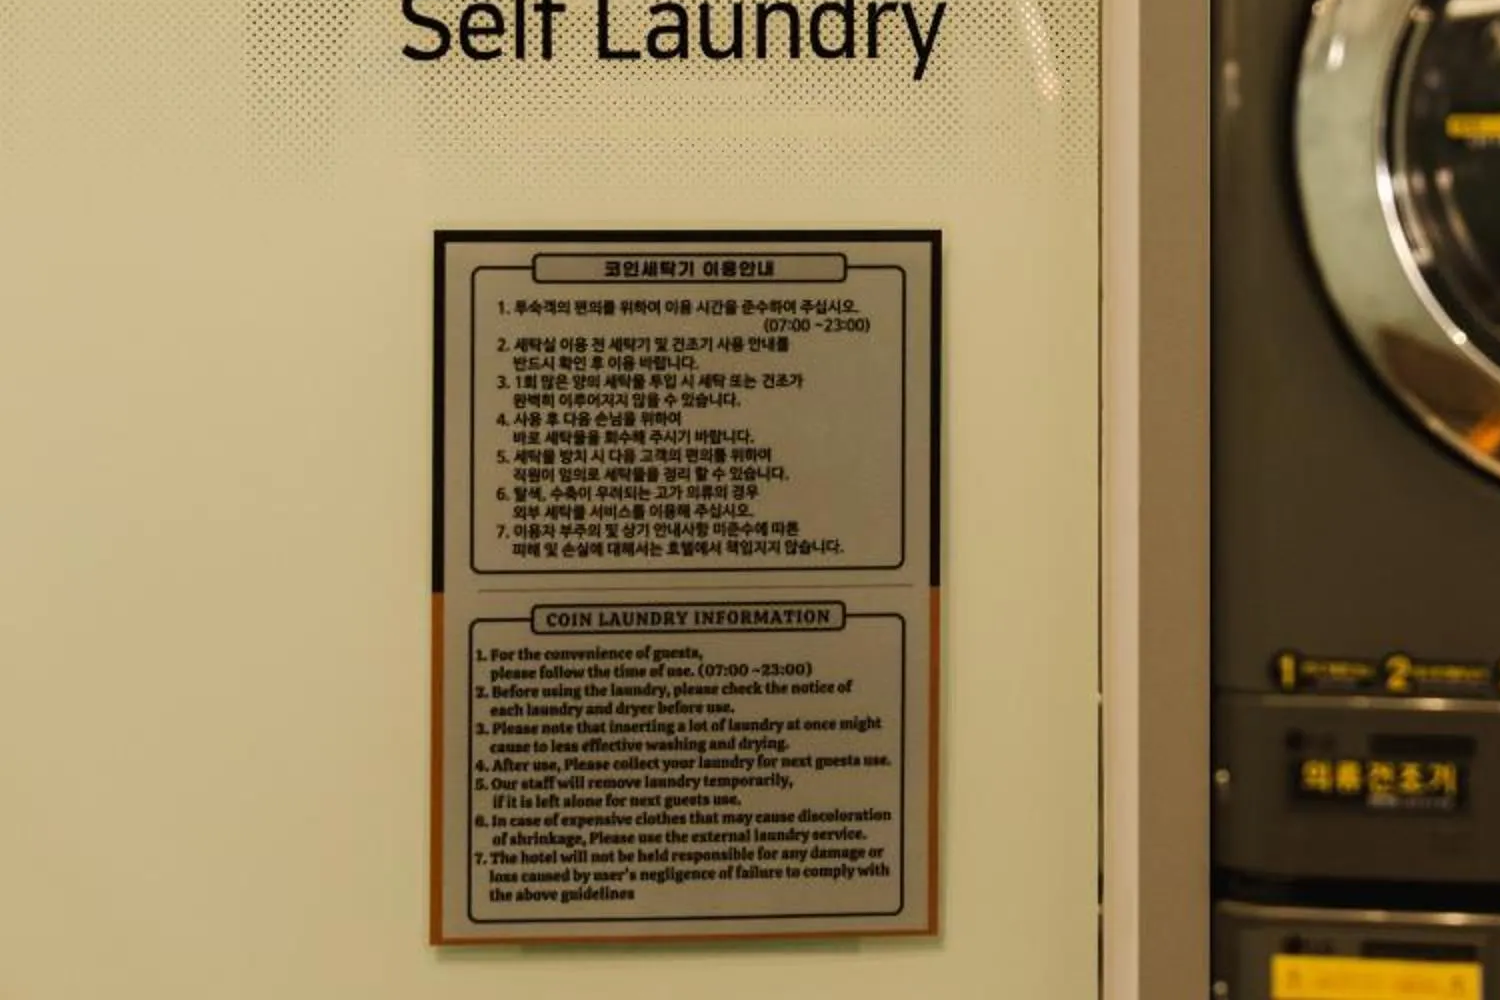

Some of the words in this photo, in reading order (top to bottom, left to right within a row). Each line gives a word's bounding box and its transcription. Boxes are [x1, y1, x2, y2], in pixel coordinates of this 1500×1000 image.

[604, 260, 694, 277] 코인세탁기
[702, 259, 774, 277] 이용안내
[498, 300, 510, 314] 1.
[574, 299, 616, 315] 편의를
[619, 299, 660, 316] 위하여
[664, 299, 692, 315] 이용
[696, 299, 738, 315] 시간을
[741, 299, 796, 315] 준수하여
[800, 299, 859, 314] 주십시오.
[496, 337, 510, 352] 2.
[513, 336, 556, 353] 세탁실
[559, 336, 588, 353] 이용
[591, 336, 604, 353] 전
[608, 336, 650, 352] 세탁기
[654, 336, 668, 352] 및
[672, 336, 712, 352] 건조기
[716, 336, 744, 352] 사용
[512, 355, 554, 371] 반드시
[558, 355, 586, 371] 확인
[590, 355, 604, 370] 후
[607, 354, 636, 371] 이용
[558, 392, 628, 408] 이루어지지
[664, 392, 678, 408] 수
[681, 391, 740, 408] 있습니다.
[496, 412, 509, 426] 4.
[513, 411, 542, 428] 사용
[545, 411, 560, 427] 후
[563, 411, 592, 427] 다음
[594, 410, 636, 427] 손님을
[640, 410, 681, 426] 위하여
[512, 430, 540, 445] 바로
[544, 429, 600, 446] 세탁물을
[649, 429, 690, 445] 주시기
[603, 465, 659, 482] 세탁물을
[694, 465, 708, 482] 할
[712, 466, 726, 482] 수
[729, 465, 789, 481] 있습니다.
[546, 612, 592, 627] COIN
[598, 610, 688, 627] LAUNDRY
[694, 609, 830, 625] INFORMATION
[476, 648, 487, 661] 1.
[490, 648, 515, 662] For
[515, 647, 542, 660] the
[543, 646, 633, 660] convenience
[635, 645, 651, 659] of
[651, 646, 703, 662] guests,
[490, 665, 536, 682] please
[539, 664, 585, 679] follow
[586, 663, 610, 679] the
[613, 663, 646, 678] time
[649, 662, 665, 677] of
[666, 666, 694, 677] use.
[1279, 652, 1296, 690] 1
[1385, 653, 1411, 692] 2
[476, 687, 488, 699] 2.
[492, 683, 539, 698] Before
[541, 683, 582, 700] using
[584, 683, 608, 696] the
[610, 682, 670, 698] laundry,
[673, 681, 719, 698] please
[721, 681, 763, 695] check
[764, 680, 788, 694] the
[791, 679, 834, 694] notice
[836, 679, 852, 693] of
[489, 703, 523, 717] each
[526, 701, 584, 719] laundry
[585, 701, 612, 715] and
[615, 700, 655, 717] dryer
[657, 699, 704, 714] before
[706, 703, 734, 713] use.
[489, 742, 530, 753] cause
[532, 740, 548, 753] to
[550, 739, 578, 753] less
[581, 737, 643, 752] effective
[644, 736, 706, 755] washing
[708, 735, 736, 750] and
[738, 735, 789, 754] drying.
[475, 761, 489, 771] 4.
[491, 757, 530, 772] After
[532, 760, 562, 773] use,
[562, 756, 610, 771] Please
[612, 755, 660, 770] collect
[661, 758, 696, 772] your
[697, 754, 754, 771] laundry
[757, 754, 778, 768] for
[780, 755, 812, 767] next
[815, 754, 860, 770] guests
[863, 755, 891, 766] use.
[475, 779, 488, 790] 5.
[490, 777, 518, 790] Our
[520, 775, 556, 790] staff
[556, 775, 584, 789] will
[587, 778, 642, 789] remove
[644, 774, 700, 790] laundry
[703, 773, 793, 790] temporarily,
[492, 793, 504, 808] if
[504, 794, 517, 808] it
[520, 794, 532, 808] is
[535, 793, 560, 808] left
[563, 793, 602, 808] alone
[605, 792, 627, 807] for
[629, 794, 661, 807] next
[664, 793, 710, 809] guests
[713, 794, 741, 805] use.
[475, 816, 488, 827] 6.
[491, 814, 506, 827] In
[509, 816, 541, 827] case
[543, 812, 559, 827] of
[560, 811, 632, 829] expensive
[634, 810, 686, 825] clothes
[689, 810, 719, 824] that
[721, 813, 753, 826] may
[754, 812, 795, 823] cause
[796, 808, 891, 822] discoloration
[475, 854, 488, 865] 7.
[489, 850, 518, 864] The
[520, 849, 557, 864] hotel
[559, 849, 587, 863] will
[590, 850, 614, 863] not
[617, 848, 634, 863] be
[637, 847, 668, 862] held
[671, 847, 754, 866] responsible
[757, 846, 778, 860] for
[780, 848, 808, 862] any
[809, 845, 866, 862] damage
[868, 847, 884, 858] or
[489, 887, 512, 902] the
[515, 887, 558, 901] above
[560, 886, 634, 903] guidelines
